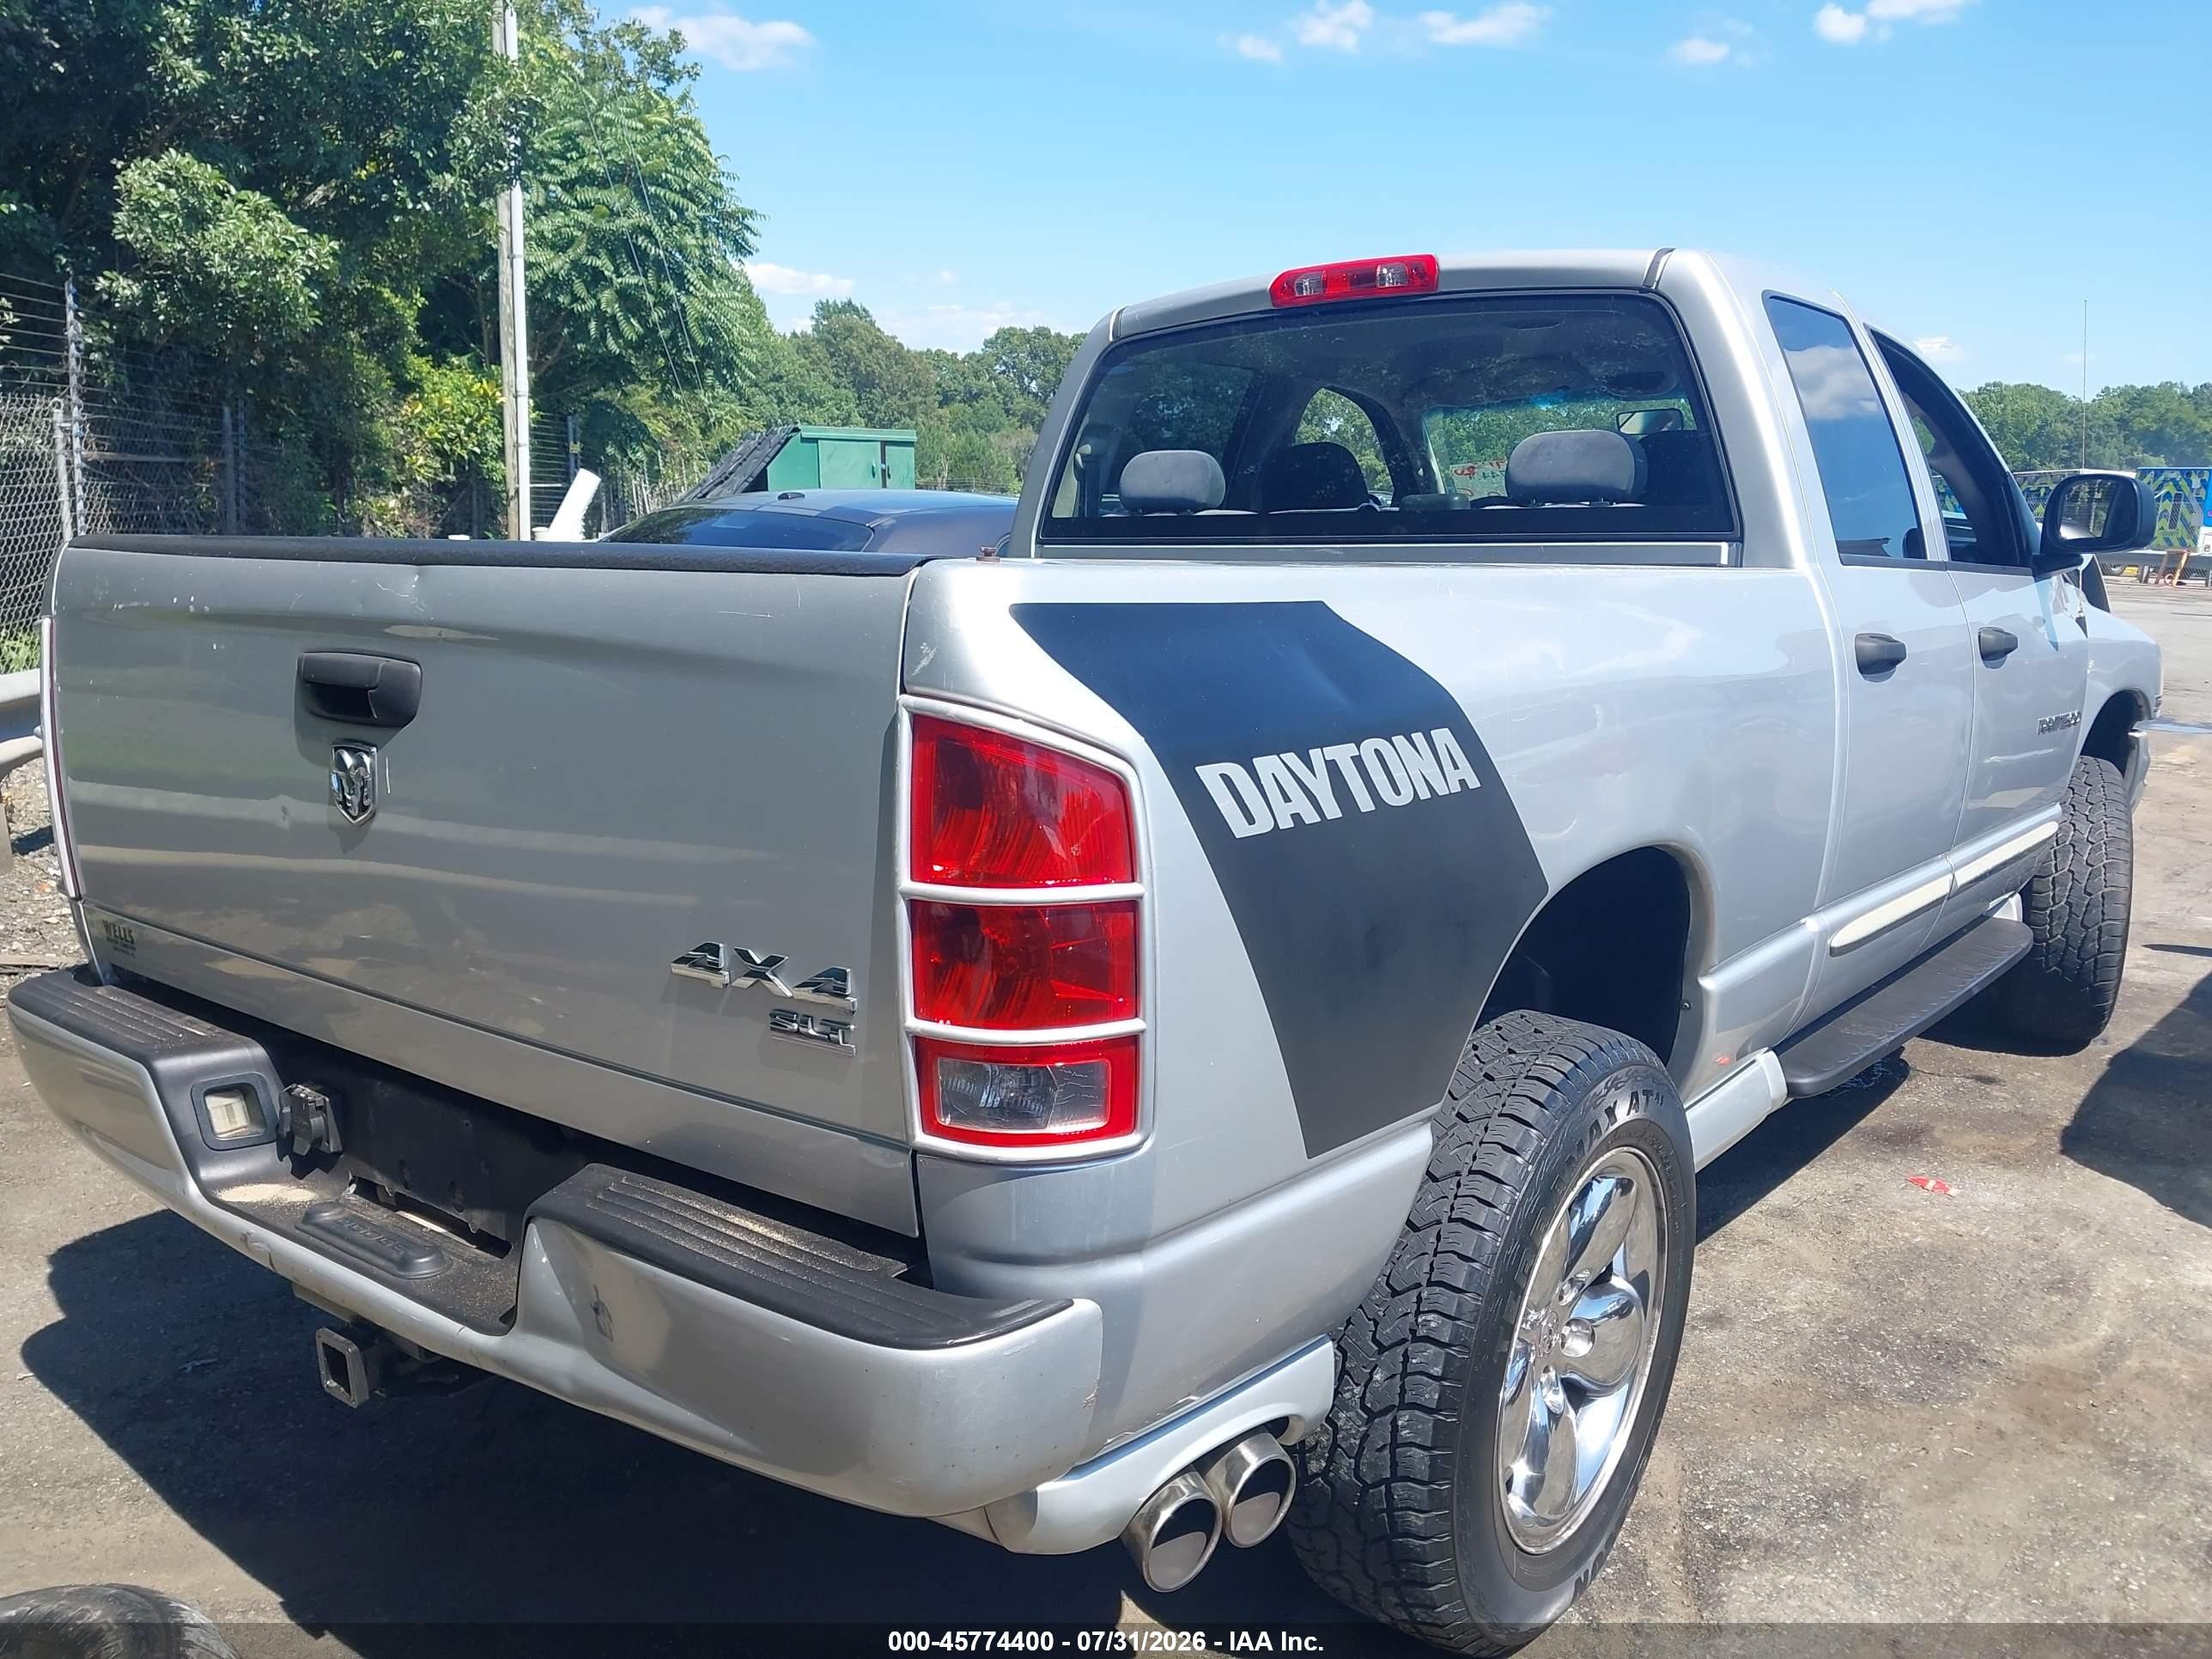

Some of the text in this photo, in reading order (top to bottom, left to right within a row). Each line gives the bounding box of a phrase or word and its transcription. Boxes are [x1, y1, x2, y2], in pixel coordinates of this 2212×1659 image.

[1194, 727, 1481, 839] DAYTONA
[102, 920, 135, 945] WELLS
[769, 1008, 857, 1056] SLT
